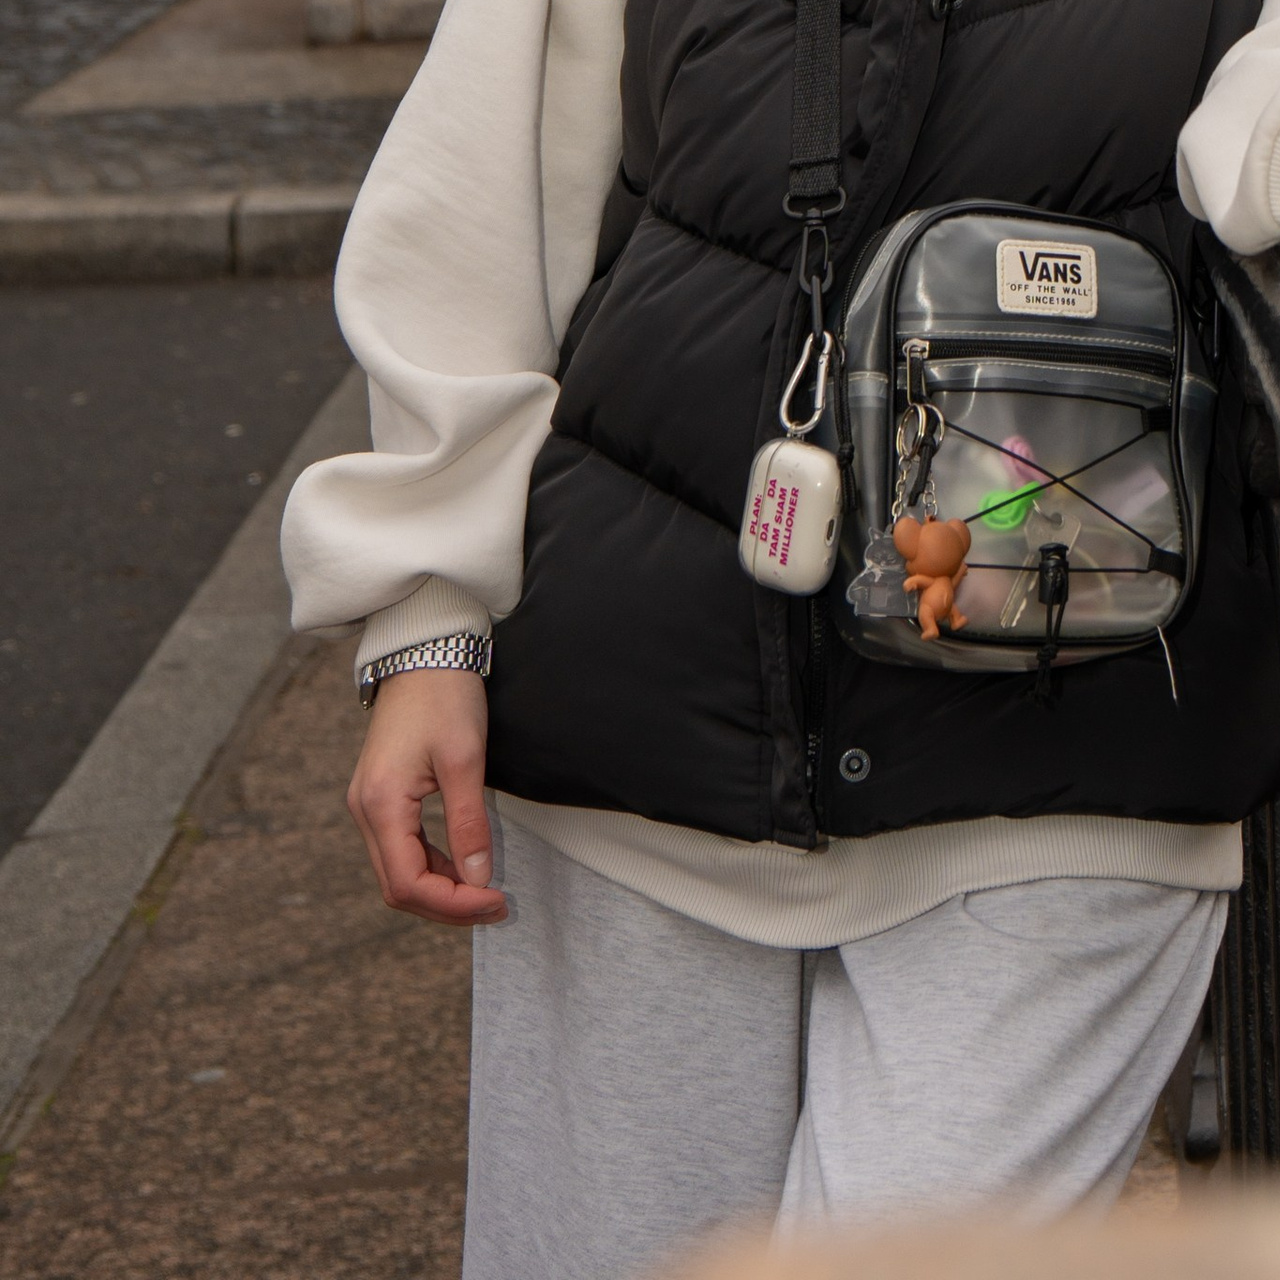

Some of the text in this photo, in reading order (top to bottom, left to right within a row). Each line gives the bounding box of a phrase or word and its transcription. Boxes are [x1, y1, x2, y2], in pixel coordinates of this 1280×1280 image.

[1019, 251, 1082, 284] VANS
[1037, 285, 1056, 294] THE
[750, 494, 763, 536] PLAN:
[759, 479, 777, 542] DA DA
[768, 487, 787, 558] TAM SIAM
[779, 486, 800, 566] MILLIONER
